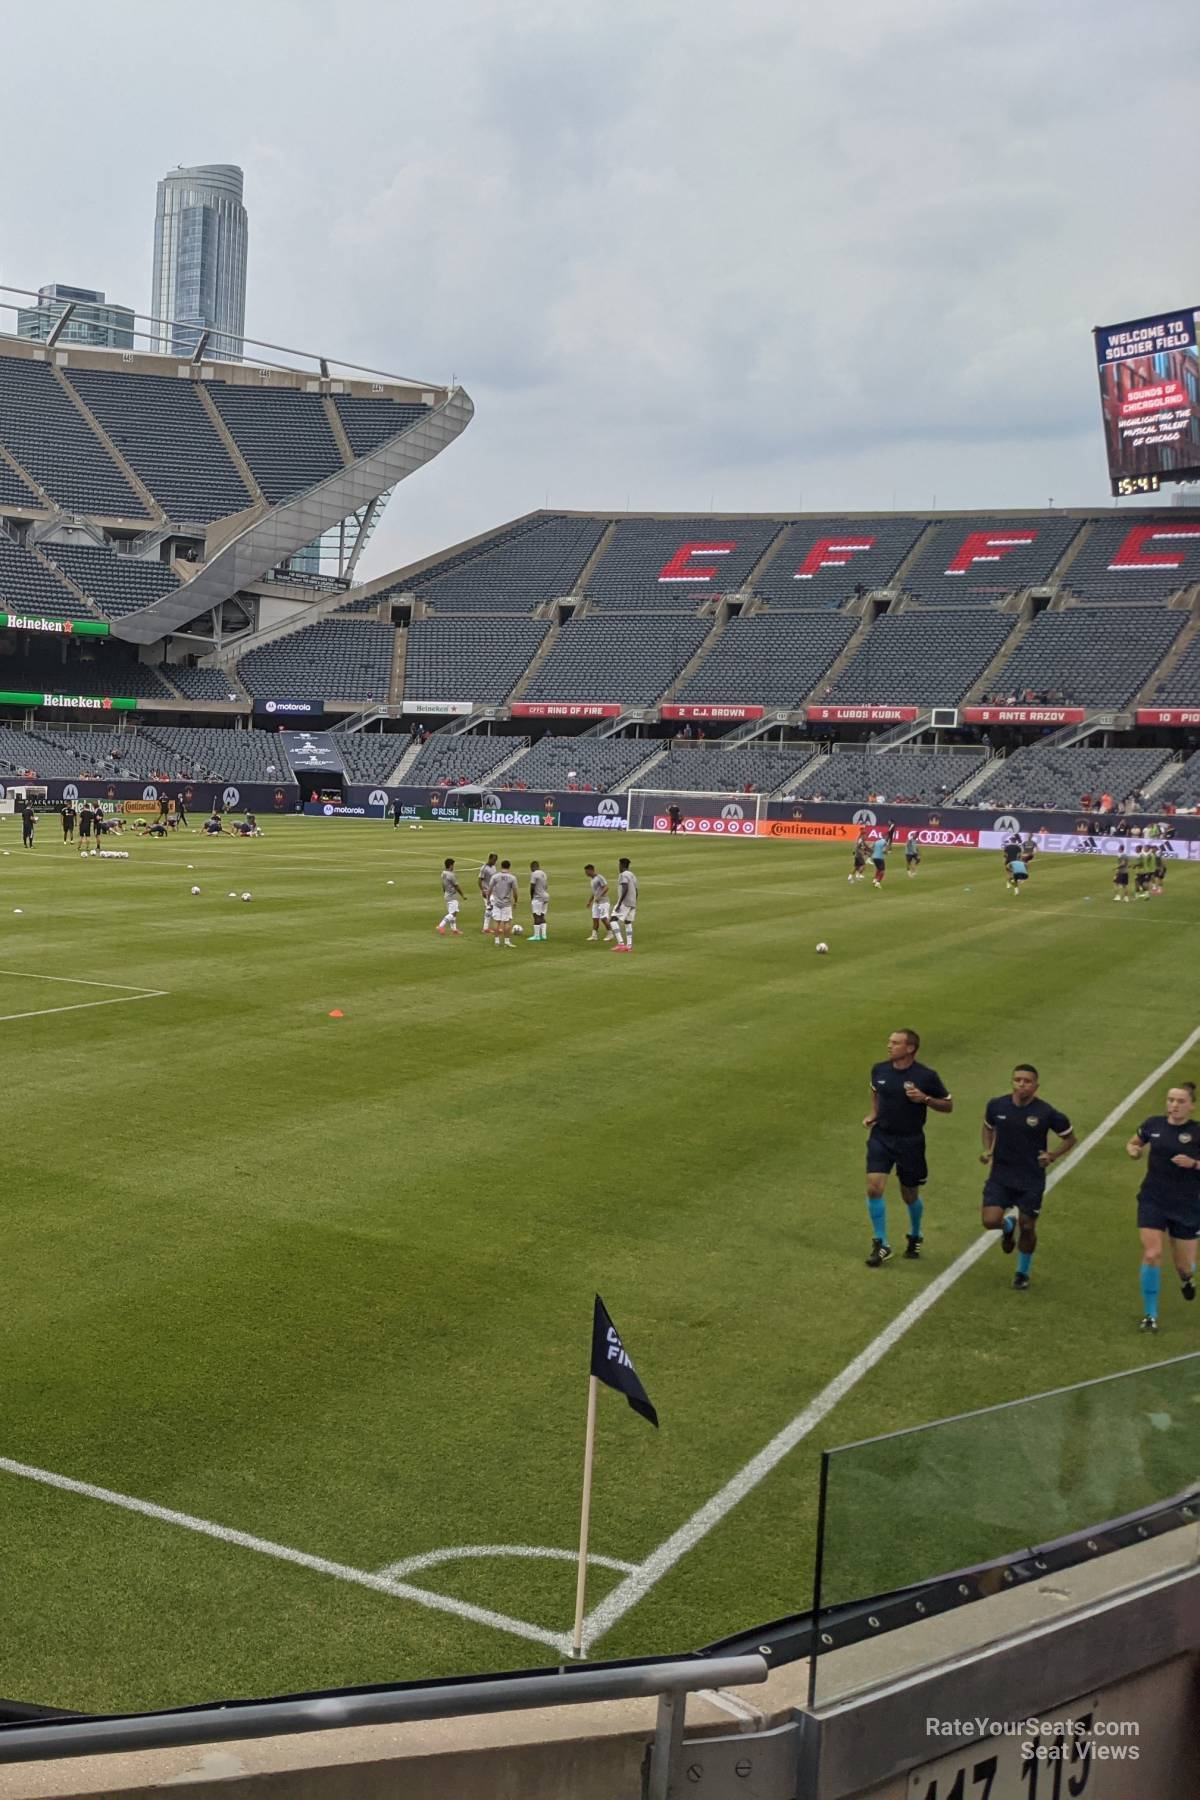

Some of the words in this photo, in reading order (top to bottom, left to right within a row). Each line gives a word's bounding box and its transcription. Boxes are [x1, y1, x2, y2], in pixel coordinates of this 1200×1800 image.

[1108, 324, 1166, 346] WELCOME
[1168, 321, 1184, 333] TO
[1105, 340, 1153, 360] SOLDIER
[1156, 333, 1189, 348] FIELD
[1127, 386, 1163, 401] SOUNDS
[1165, 383, 1177, 395] OF
[1175, 408, 1191, 419] THE
[1123, 424, 1157, 438] MUSICAL
[1159, 419, 1189, 432] TALENT
[1133, 436, 1145, 446] OF
[1146, 432, 1180, 446] CHICAGO
[1117, 476, 1159, 495] 15:41
[7, 615, 63, 632] Heineken
[43, 694, 101, 709] Heineken
[277, 703, 311, 711] motorola
[547, 707, 567, 715] RING
[570, 707, 581, 715] OF
[583, 707, 603, 715] FIRE
[693, 709, 709, 717] C.J.
[711, 709, 745, 717] BROWN
[837, 710, 869, 719] LUBOS
[871, 710, 901, 719] KUBIK
[999, 712, 1026, 720] ANTE
[1029, 712, 1065, 721] RAZOV
[1159, 713, 1171, 722] 10
[125, 800, 156, 813] Continental
[333, 805, 365, 815] motorola
[400, 807, 416, 815] USH
[438, 808, 459, 816] RUSH
[473, 809, 540, 825] Heineken
[582, 815, 628, 829] Gillette
[770, 822, 837, 837] Continental
